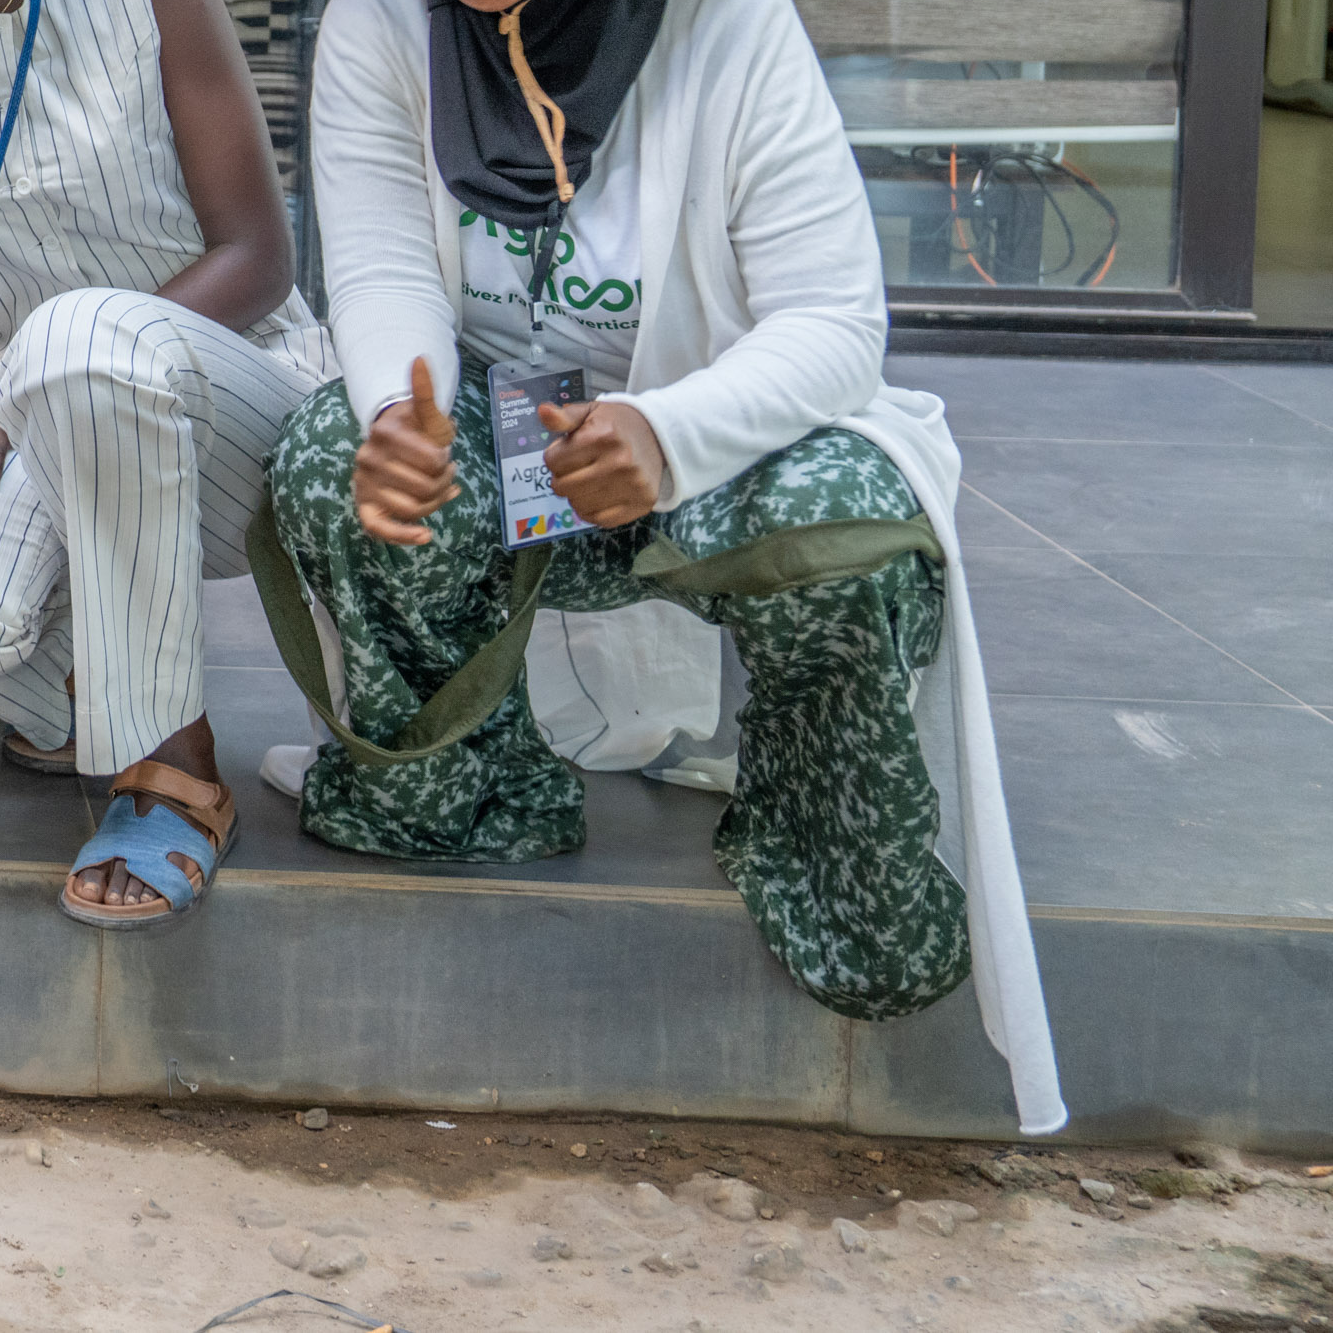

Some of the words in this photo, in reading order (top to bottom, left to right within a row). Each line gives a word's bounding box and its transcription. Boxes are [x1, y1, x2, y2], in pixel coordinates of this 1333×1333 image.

[499, 397, 530, 409] Summer
[500, 405, 536, 419] Challenge
[501, 418, 519, 429] 2024
